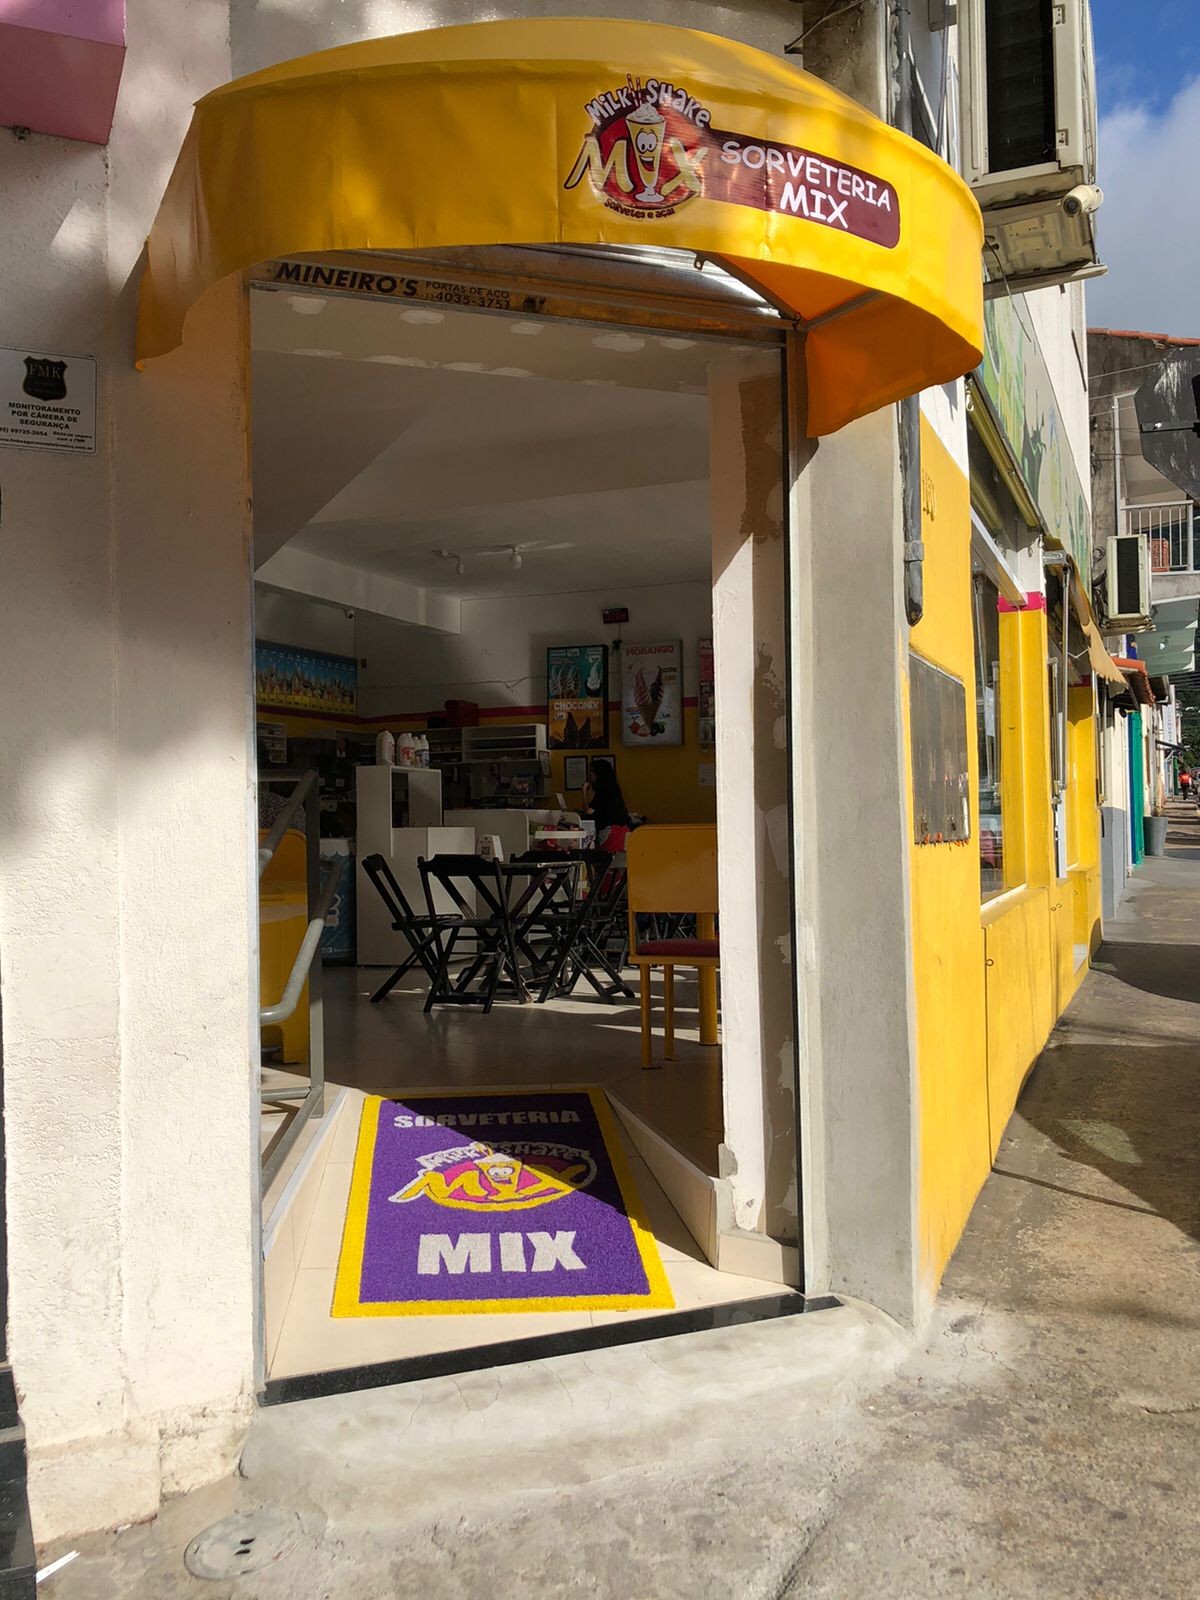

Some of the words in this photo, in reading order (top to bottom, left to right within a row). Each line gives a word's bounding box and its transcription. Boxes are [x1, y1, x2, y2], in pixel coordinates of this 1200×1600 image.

[721, 141, 891, 211] SORVETERIA
[780, 181, 848, 228] MIX
[276, 262, 418, 297] MINEIRO'S
[426, 281, 465, 293] PORTAS
[469, 287, 484, 296] DE
[29, 364, 61, 378] FMK
[9, 402, 80, 416] MONITORAMENTO
[11, 410, 28, 418] POR
[31, 410, 65, 421] CÂMERA
[19, 419, 70, 430] SEGURANÇA
[626, 646, 674, 656] MORANGO
[553, 701, 599, 712] CHOCOMIX
[393, 1110, 581, 1129] SORVETERIA
[417, 1231, 588, 1274] MIX
